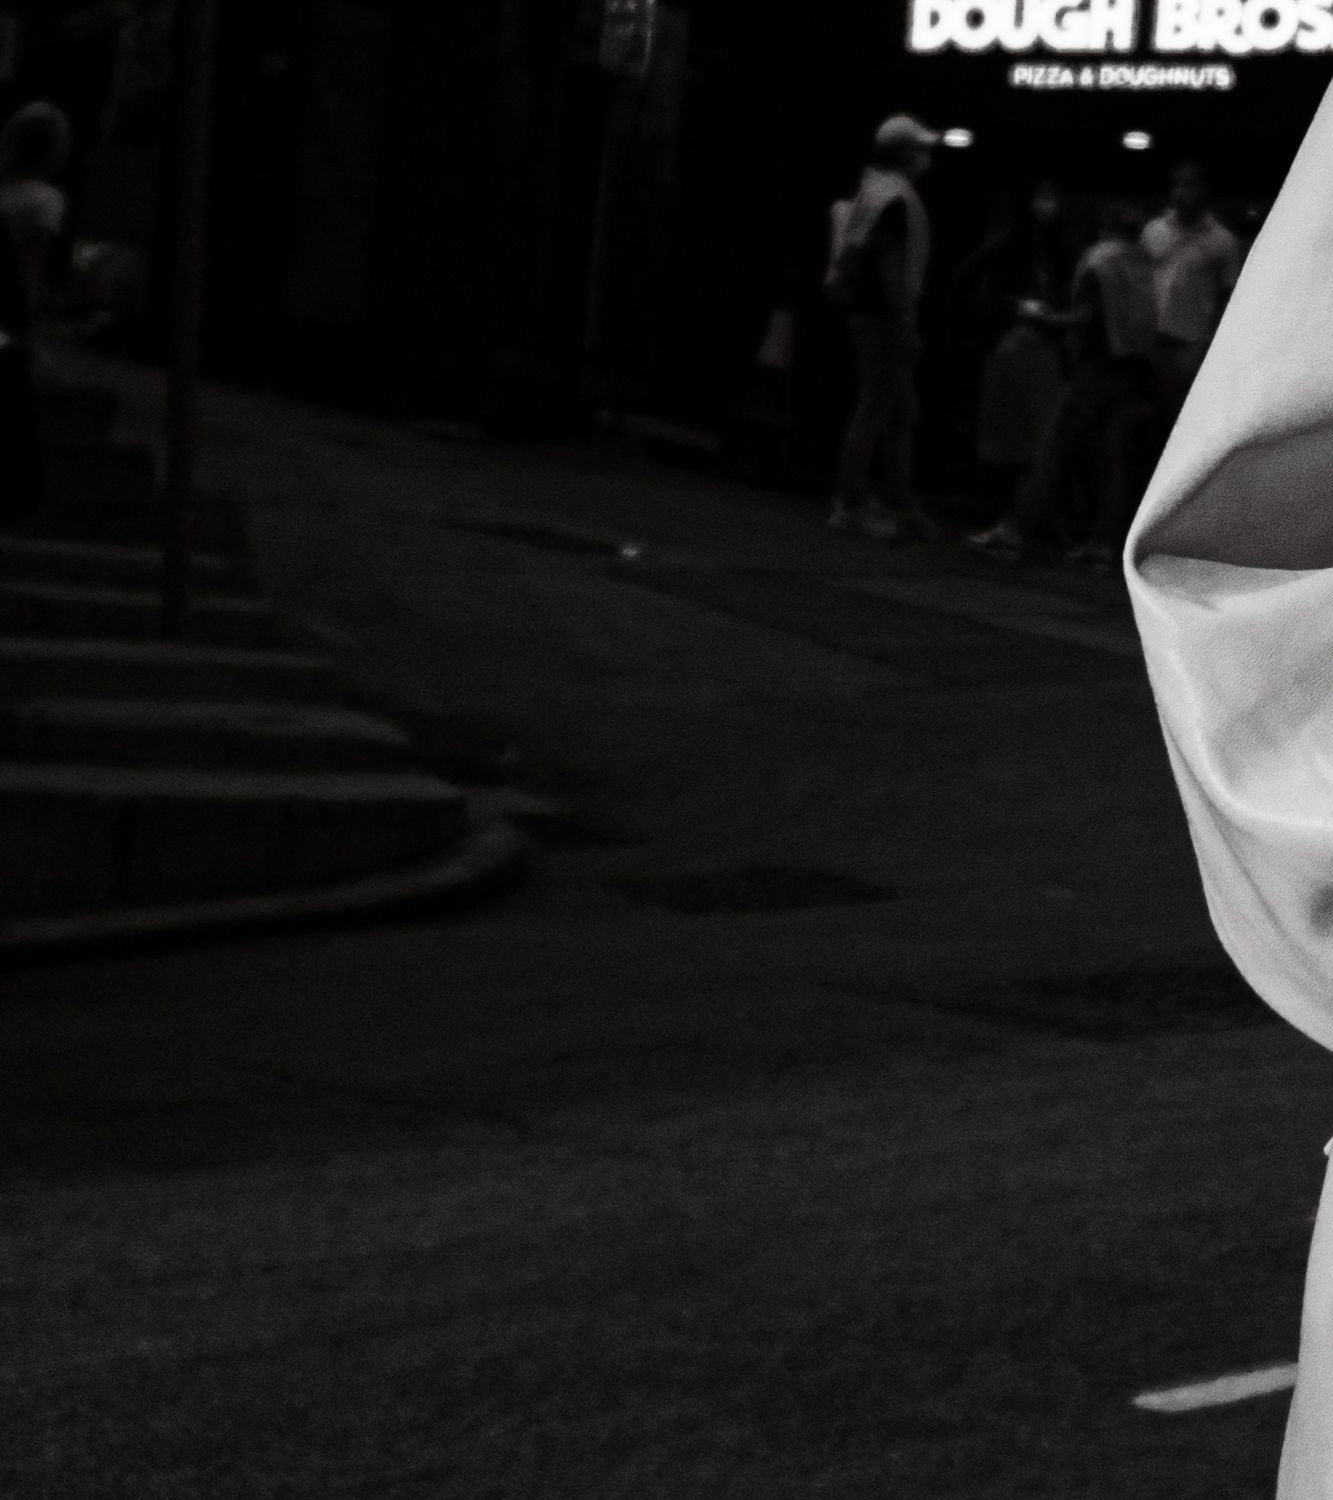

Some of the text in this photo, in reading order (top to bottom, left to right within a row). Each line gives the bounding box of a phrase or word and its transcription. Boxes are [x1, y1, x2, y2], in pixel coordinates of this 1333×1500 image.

[1010, 64, 1235, 90] PIZZA & DOUGHNUTS
